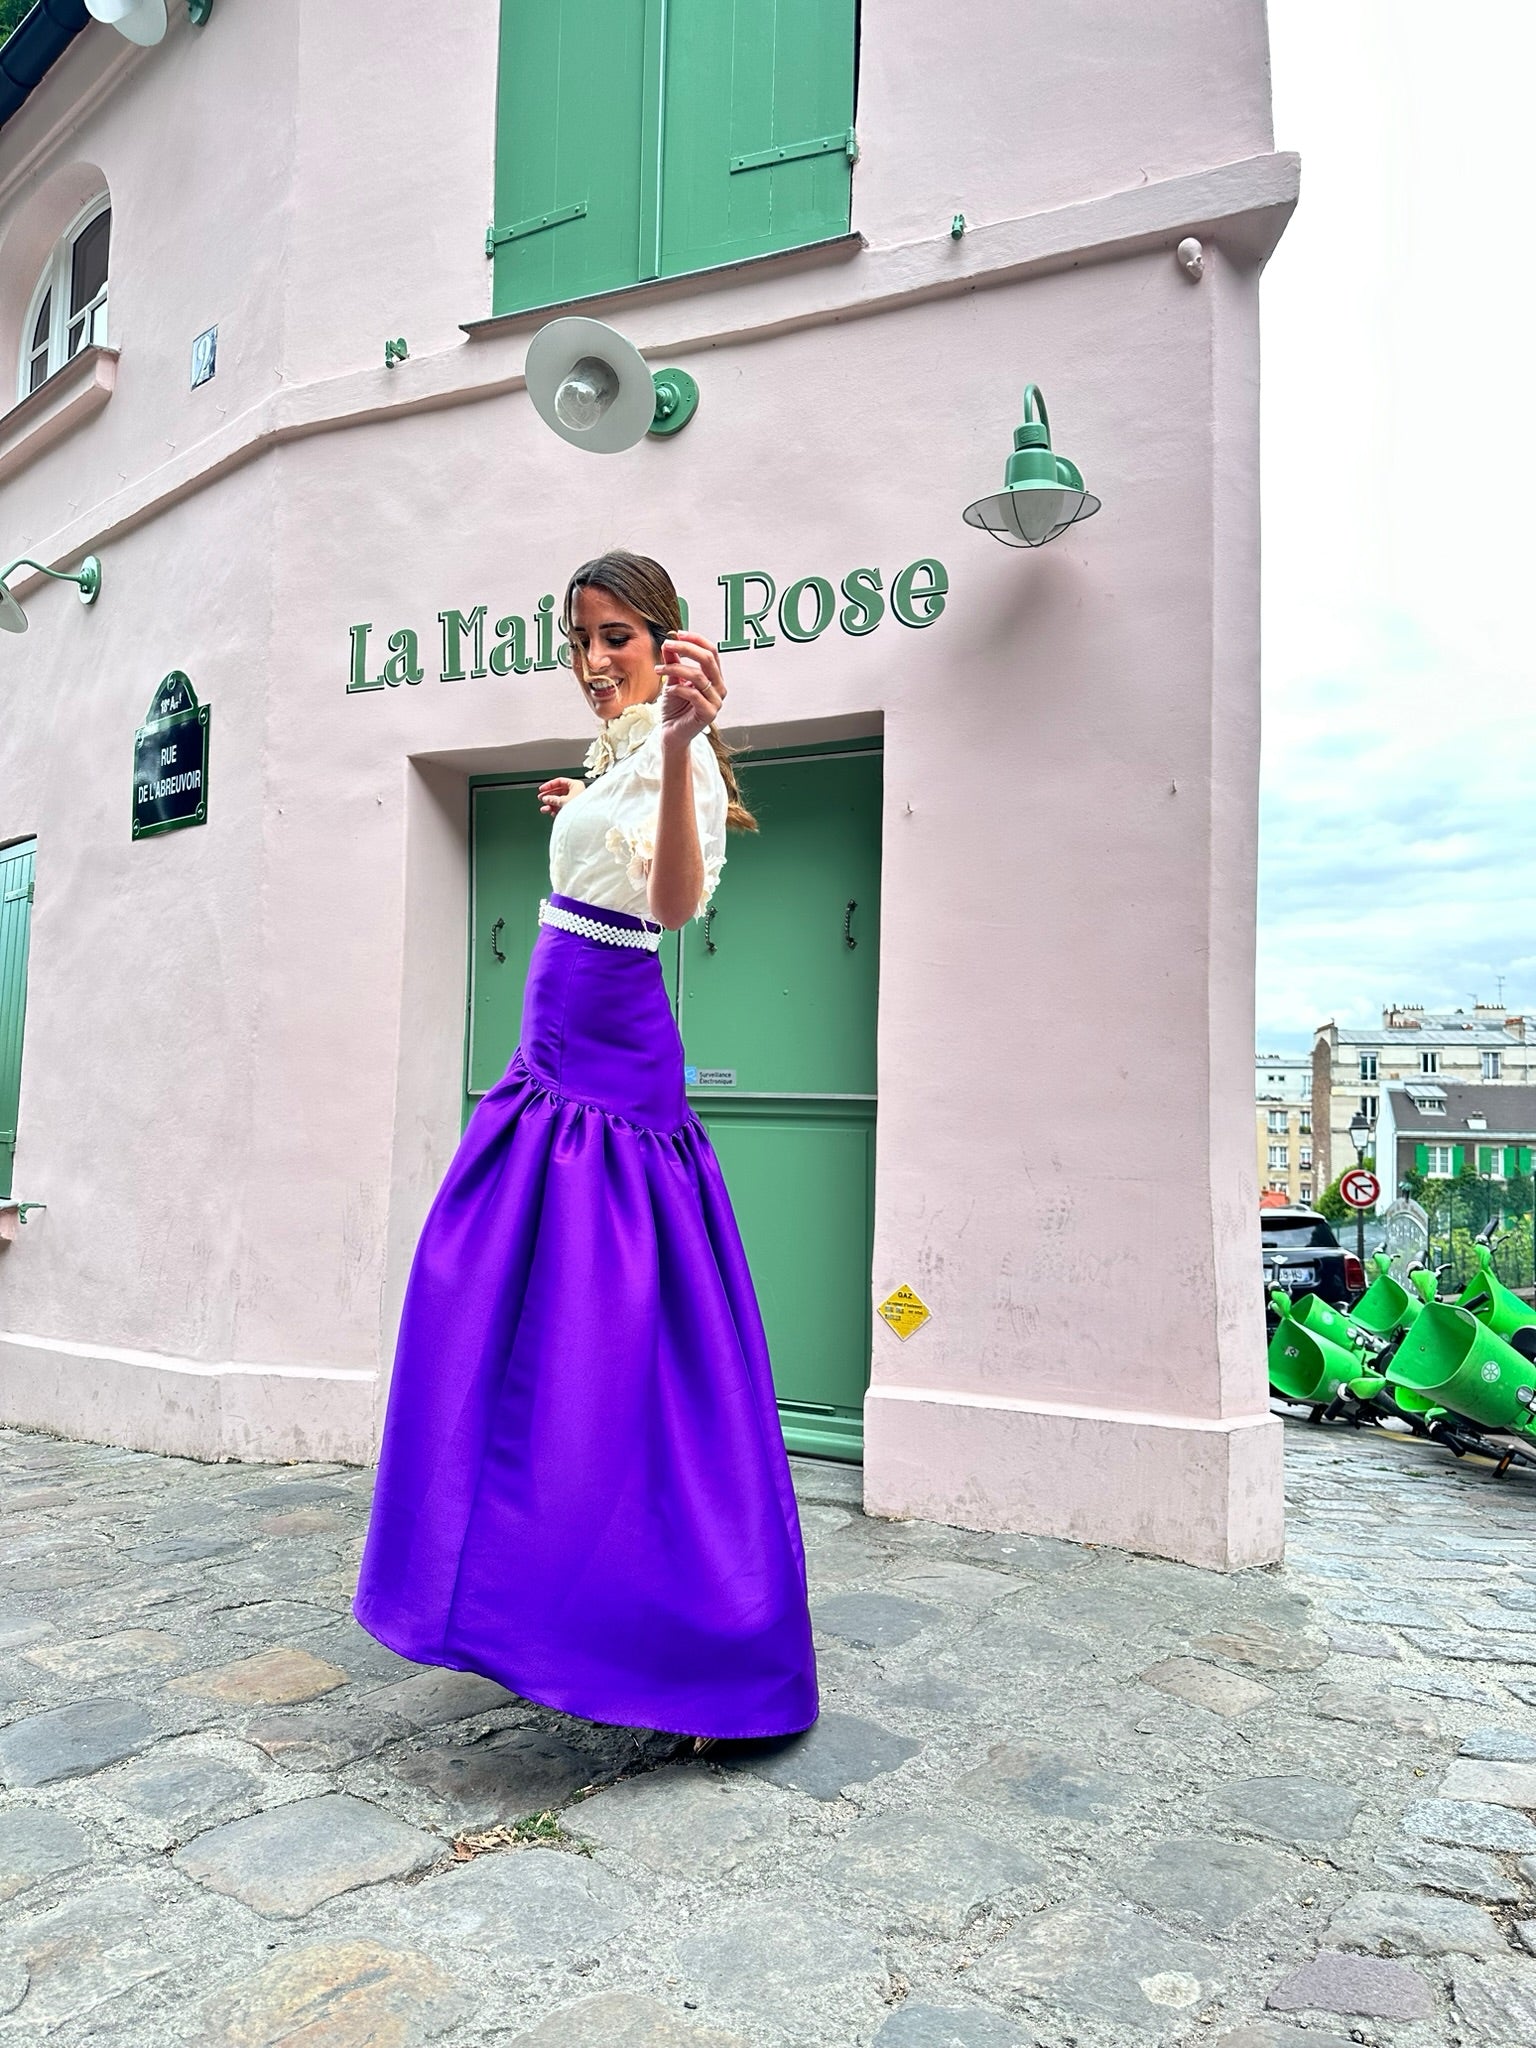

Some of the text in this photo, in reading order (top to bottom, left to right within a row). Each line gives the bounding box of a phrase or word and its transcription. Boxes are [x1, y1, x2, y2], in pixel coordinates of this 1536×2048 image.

[346, 623, 424, 694] La
[717, 557, 950, 653] Rose
[161, 745, 177, 766] RUE
[138, 769, 201, 804] DE L'ABREUVOIR
